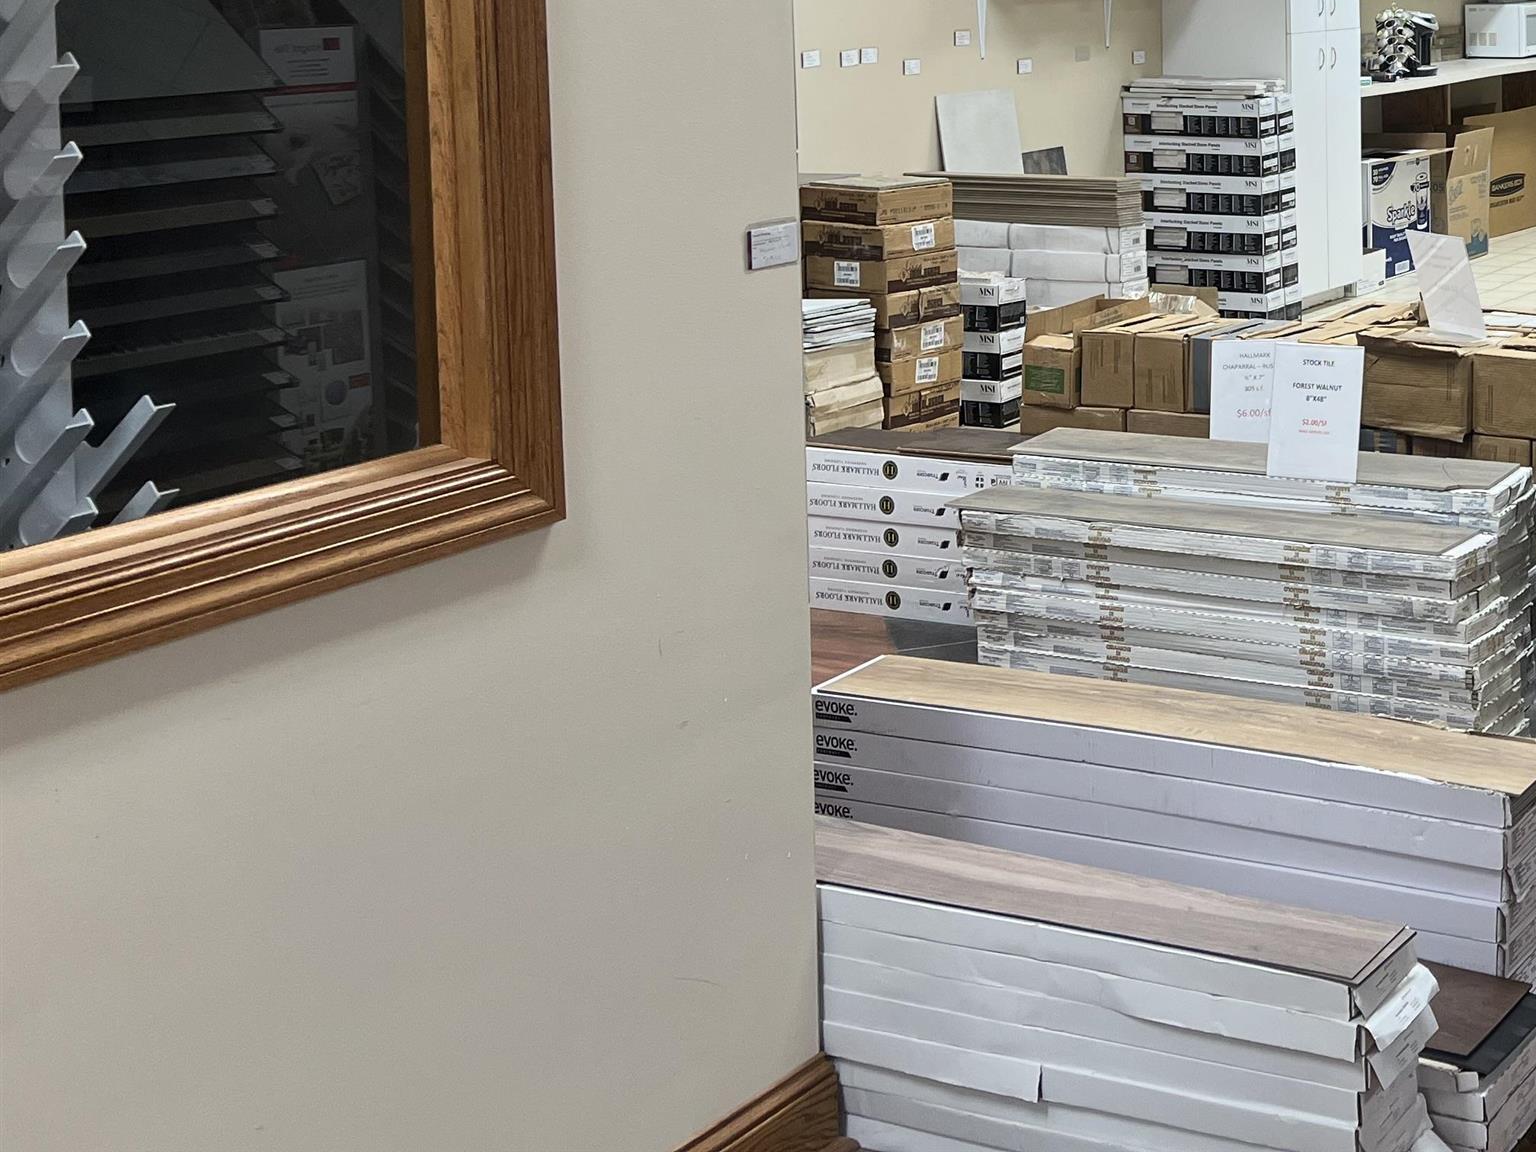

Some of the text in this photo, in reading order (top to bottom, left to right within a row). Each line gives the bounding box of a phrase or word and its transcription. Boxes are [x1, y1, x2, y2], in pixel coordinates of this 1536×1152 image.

[1387, 201, 1416, 226] Sparkle
[979, 287, 994, 296] MSI
[979, 335, 995, 344] MSI
[1302, 359, 1335, 368] STOCK TILE
[980, 384, 995, 393] MSI
[1292, 382, 1342, 392] FOREST WALNUT
[811, 463, 880, 477] HALLMARK FLOORS
[809, 498, 876, 512] HALLMARK FLOORS
[814, 530, 881, 544] HALLMARK FLOORS
[812, 561, 880, 575] HALLMARK FLOORS
[815, 591, 883, 606] HALLMARK FLOORS
